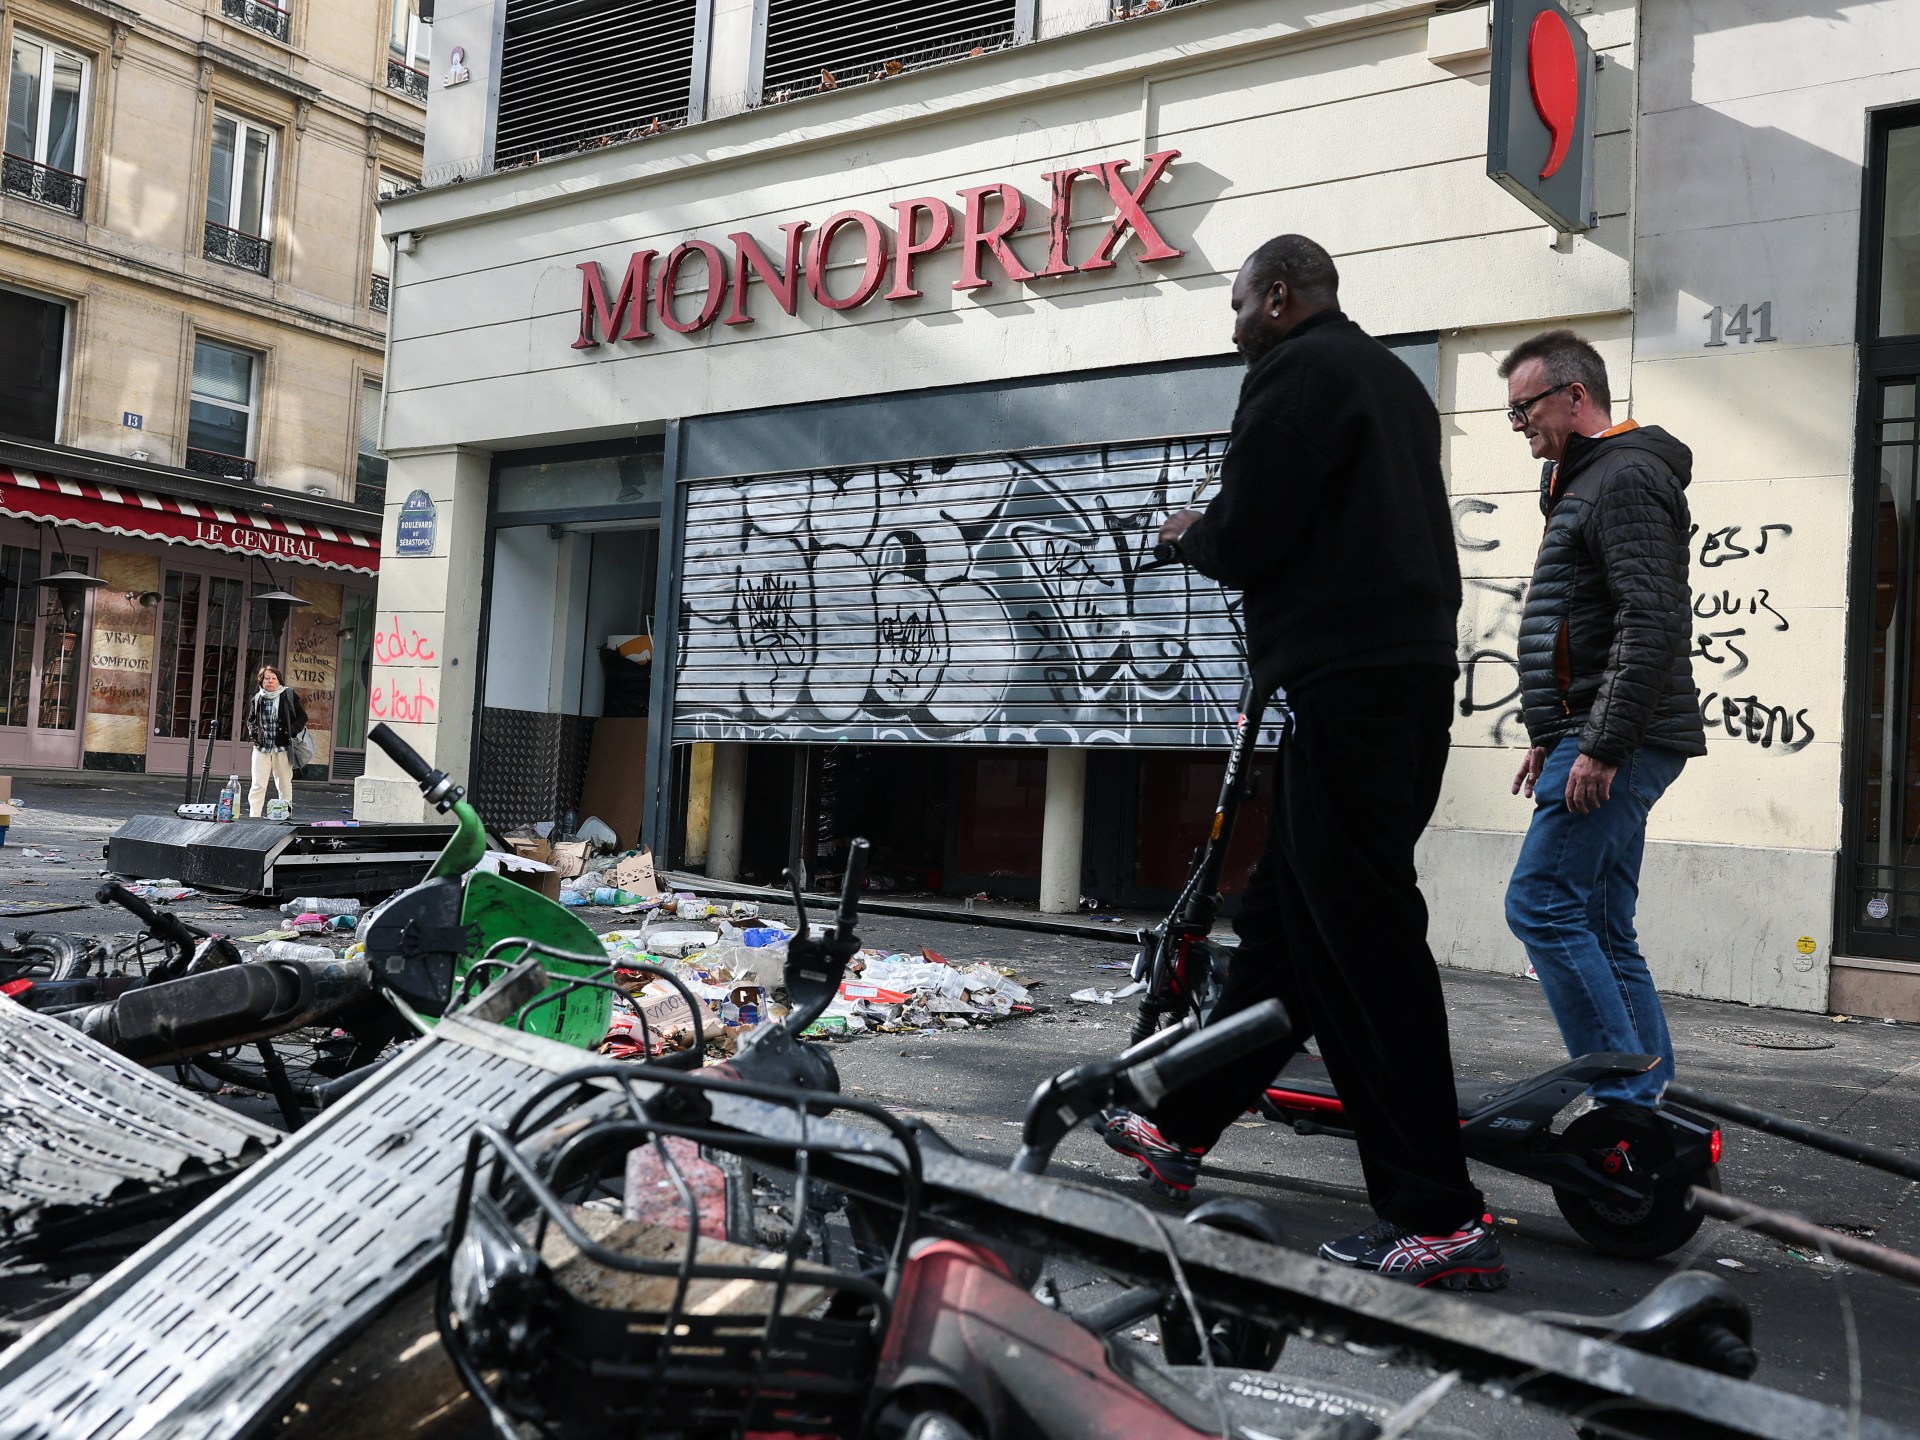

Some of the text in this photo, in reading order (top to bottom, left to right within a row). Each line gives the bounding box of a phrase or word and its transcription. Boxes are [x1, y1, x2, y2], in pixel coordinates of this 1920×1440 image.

[570, 149, 1185, 350] MONOPRIX
[1703, 300, 1778, 348] 141
[127, 414, 139, 427] 13
[401, 521, 433, 529] BOULEVARD
[195, 521, 320, 559] LE CENTRAL
[105, 631, 138, 647] VRAI
[92, 655, 149, 670] COMPTOIR
[1226, 712, 1251, 786] SEGWAY
